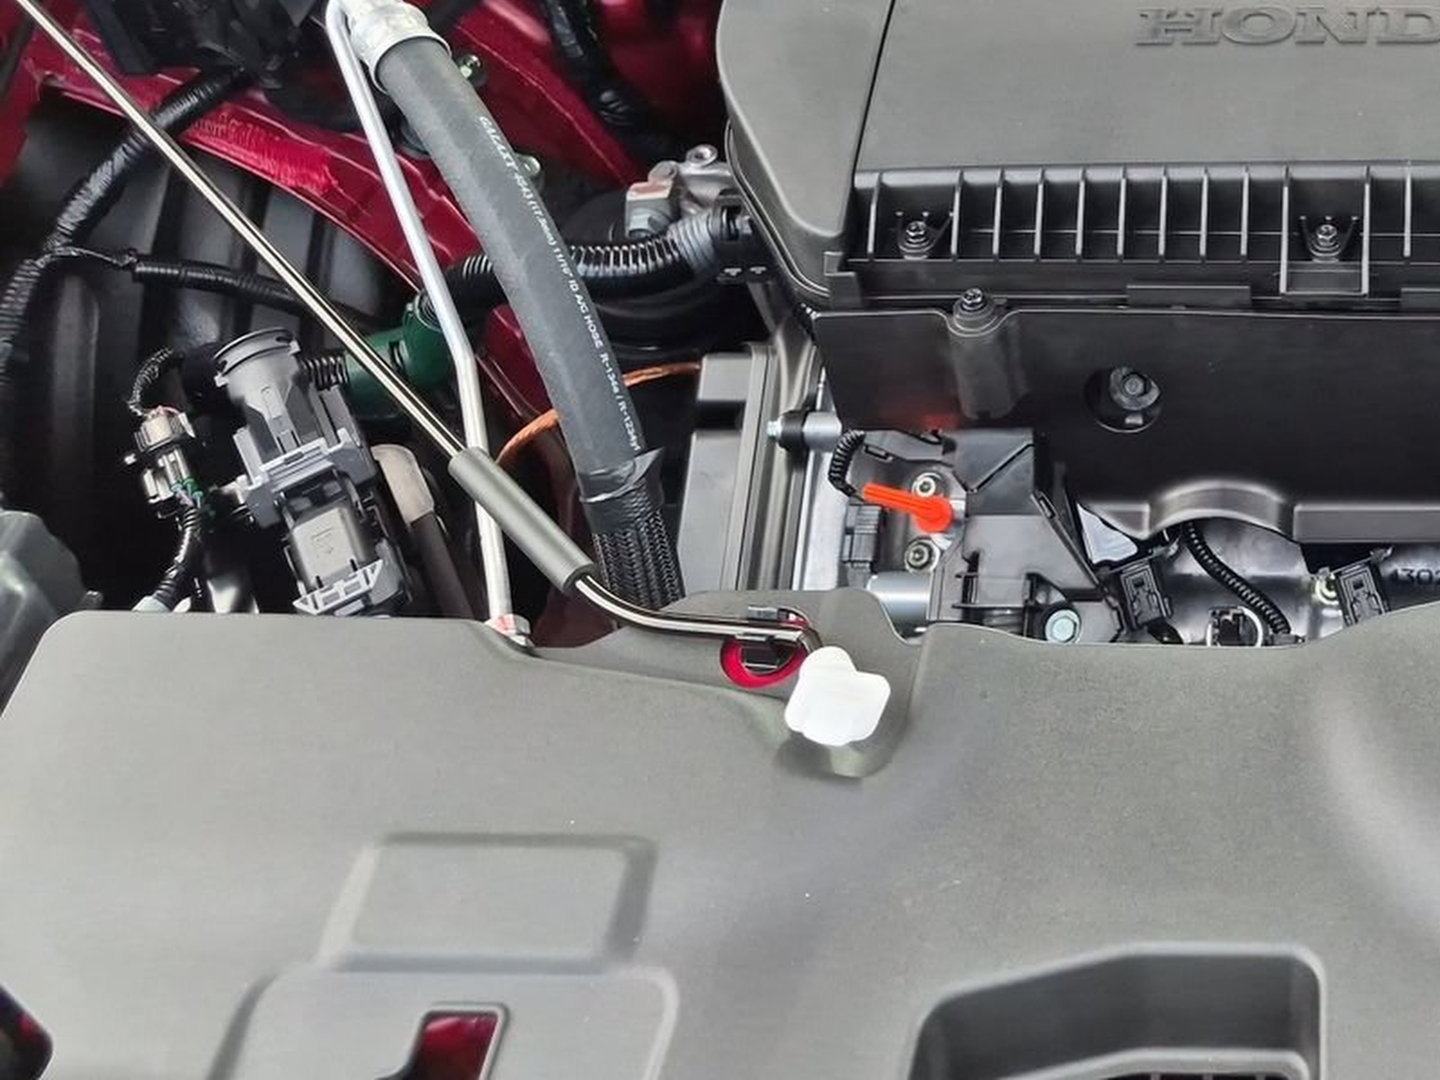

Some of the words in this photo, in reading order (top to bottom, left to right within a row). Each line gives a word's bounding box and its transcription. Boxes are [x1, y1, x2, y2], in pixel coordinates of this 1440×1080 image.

[480, 116, 519, 171] GALAXY
[568, 279, 580, 292] ID
[574, 293, 589, 314] A/C
[583, 314, 604, 349] HOSE
[600, 352, 620, 394] R-134a
